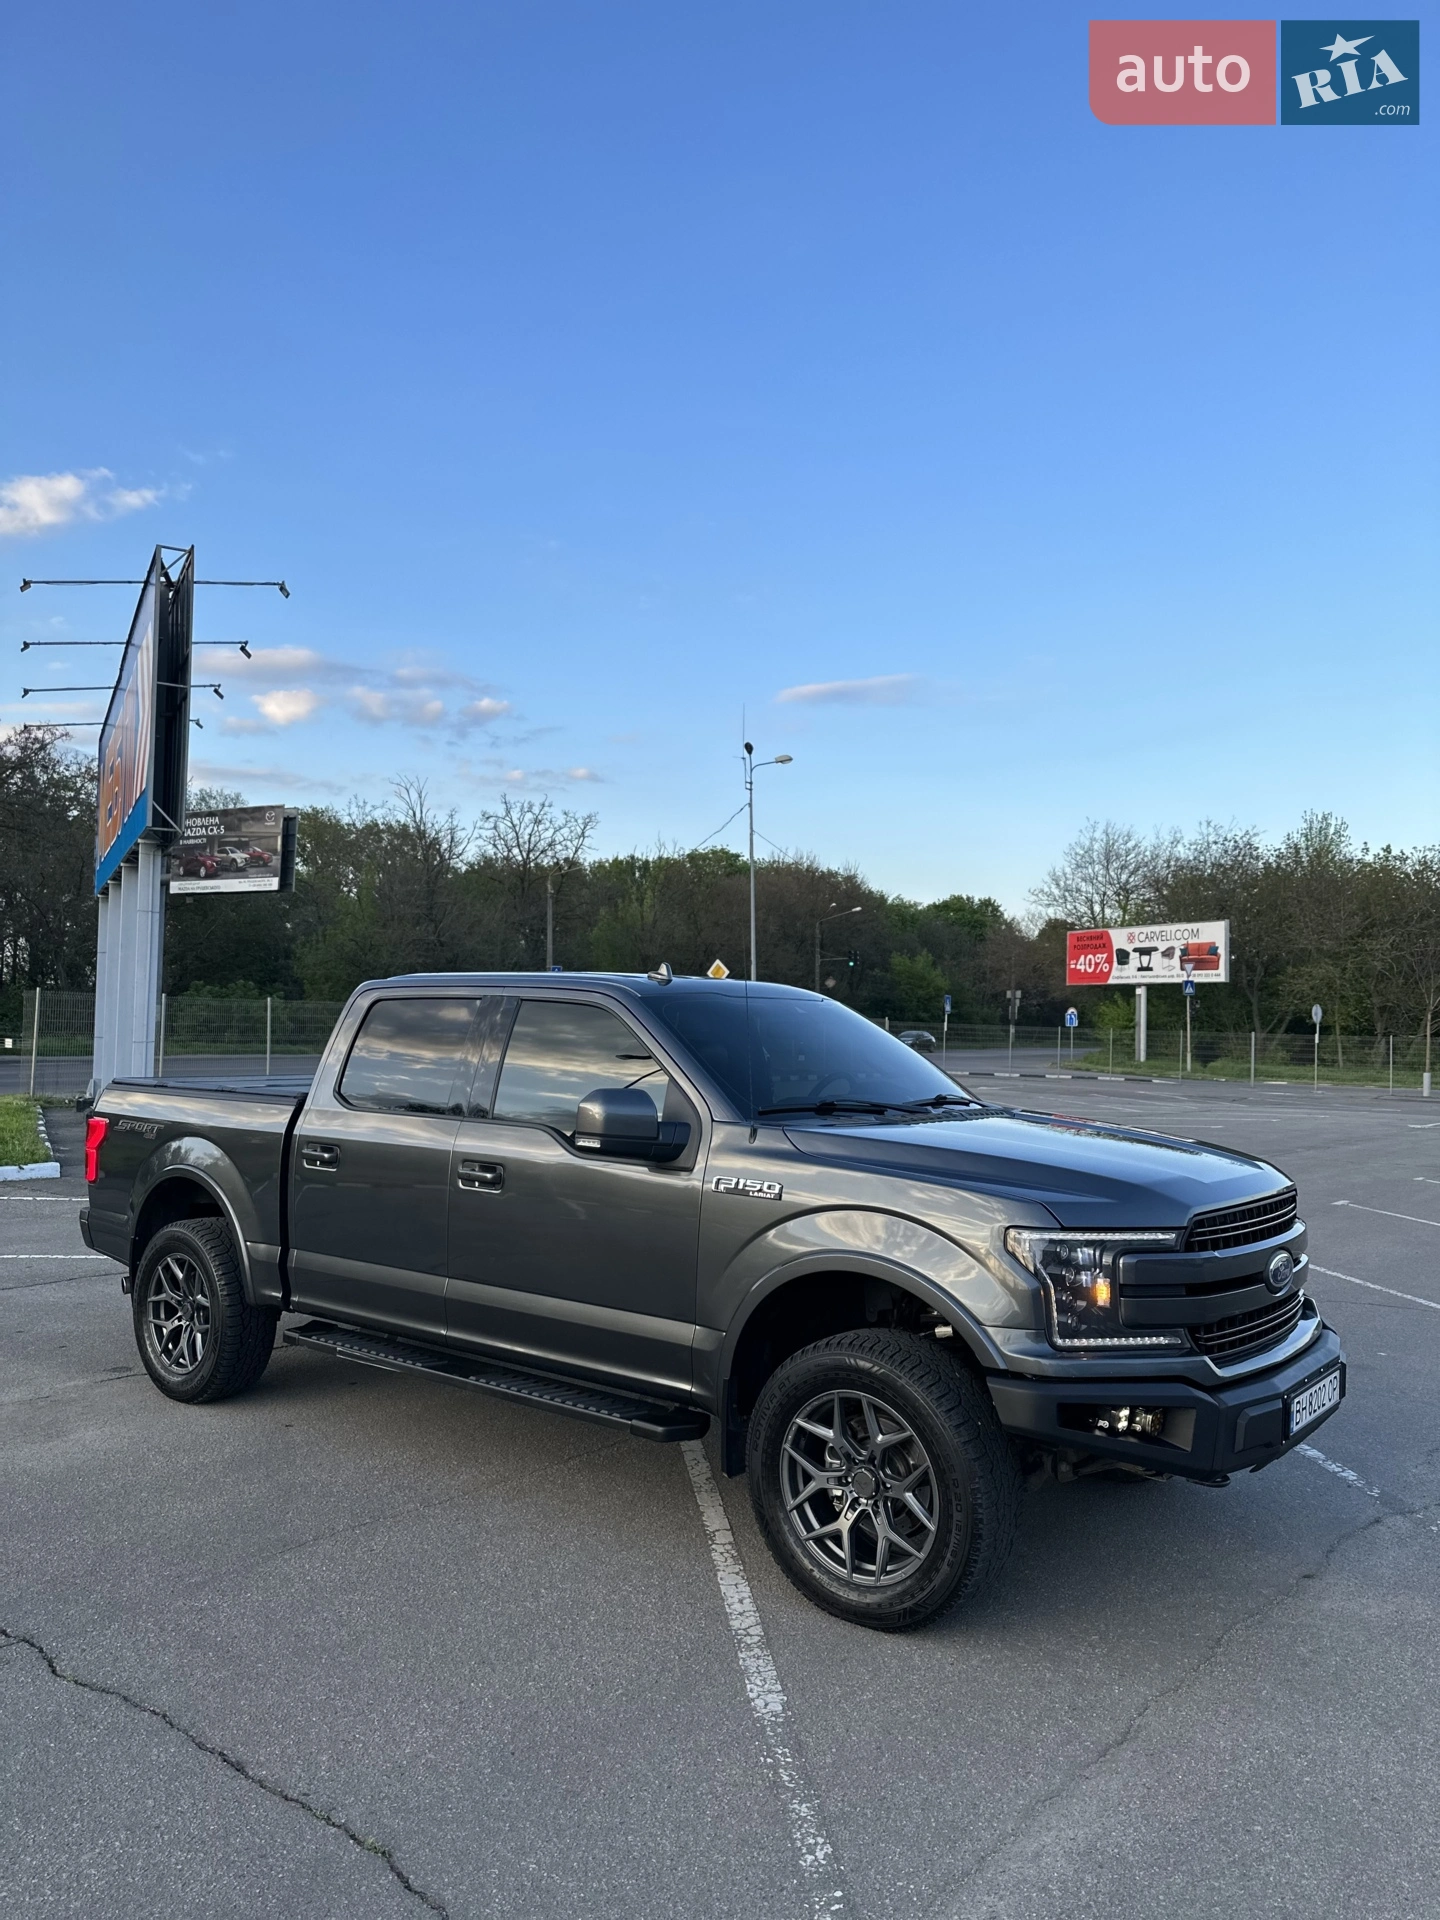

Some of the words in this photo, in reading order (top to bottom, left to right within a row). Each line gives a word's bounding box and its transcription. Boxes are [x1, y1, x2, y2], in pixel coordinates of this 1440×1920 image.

[184, 816, 220, 828] НОВЛЕНА
[207, 825, 225, 836] CX-5
[1076, 933, 1104, 943] ВЕСНЯНИЙ
[1137, 928, 1200, 943] CARVELI.COM
[1073, 943, 1107, 951] РОЗПРОДАЖ
[113, 1119, 165, 1134] SPORT
[749, 1190, 776, 1199] LARIAT
[1295, 1395, 1308, 1427] BH
[1308, 1383, 1327, 1417] 8202
